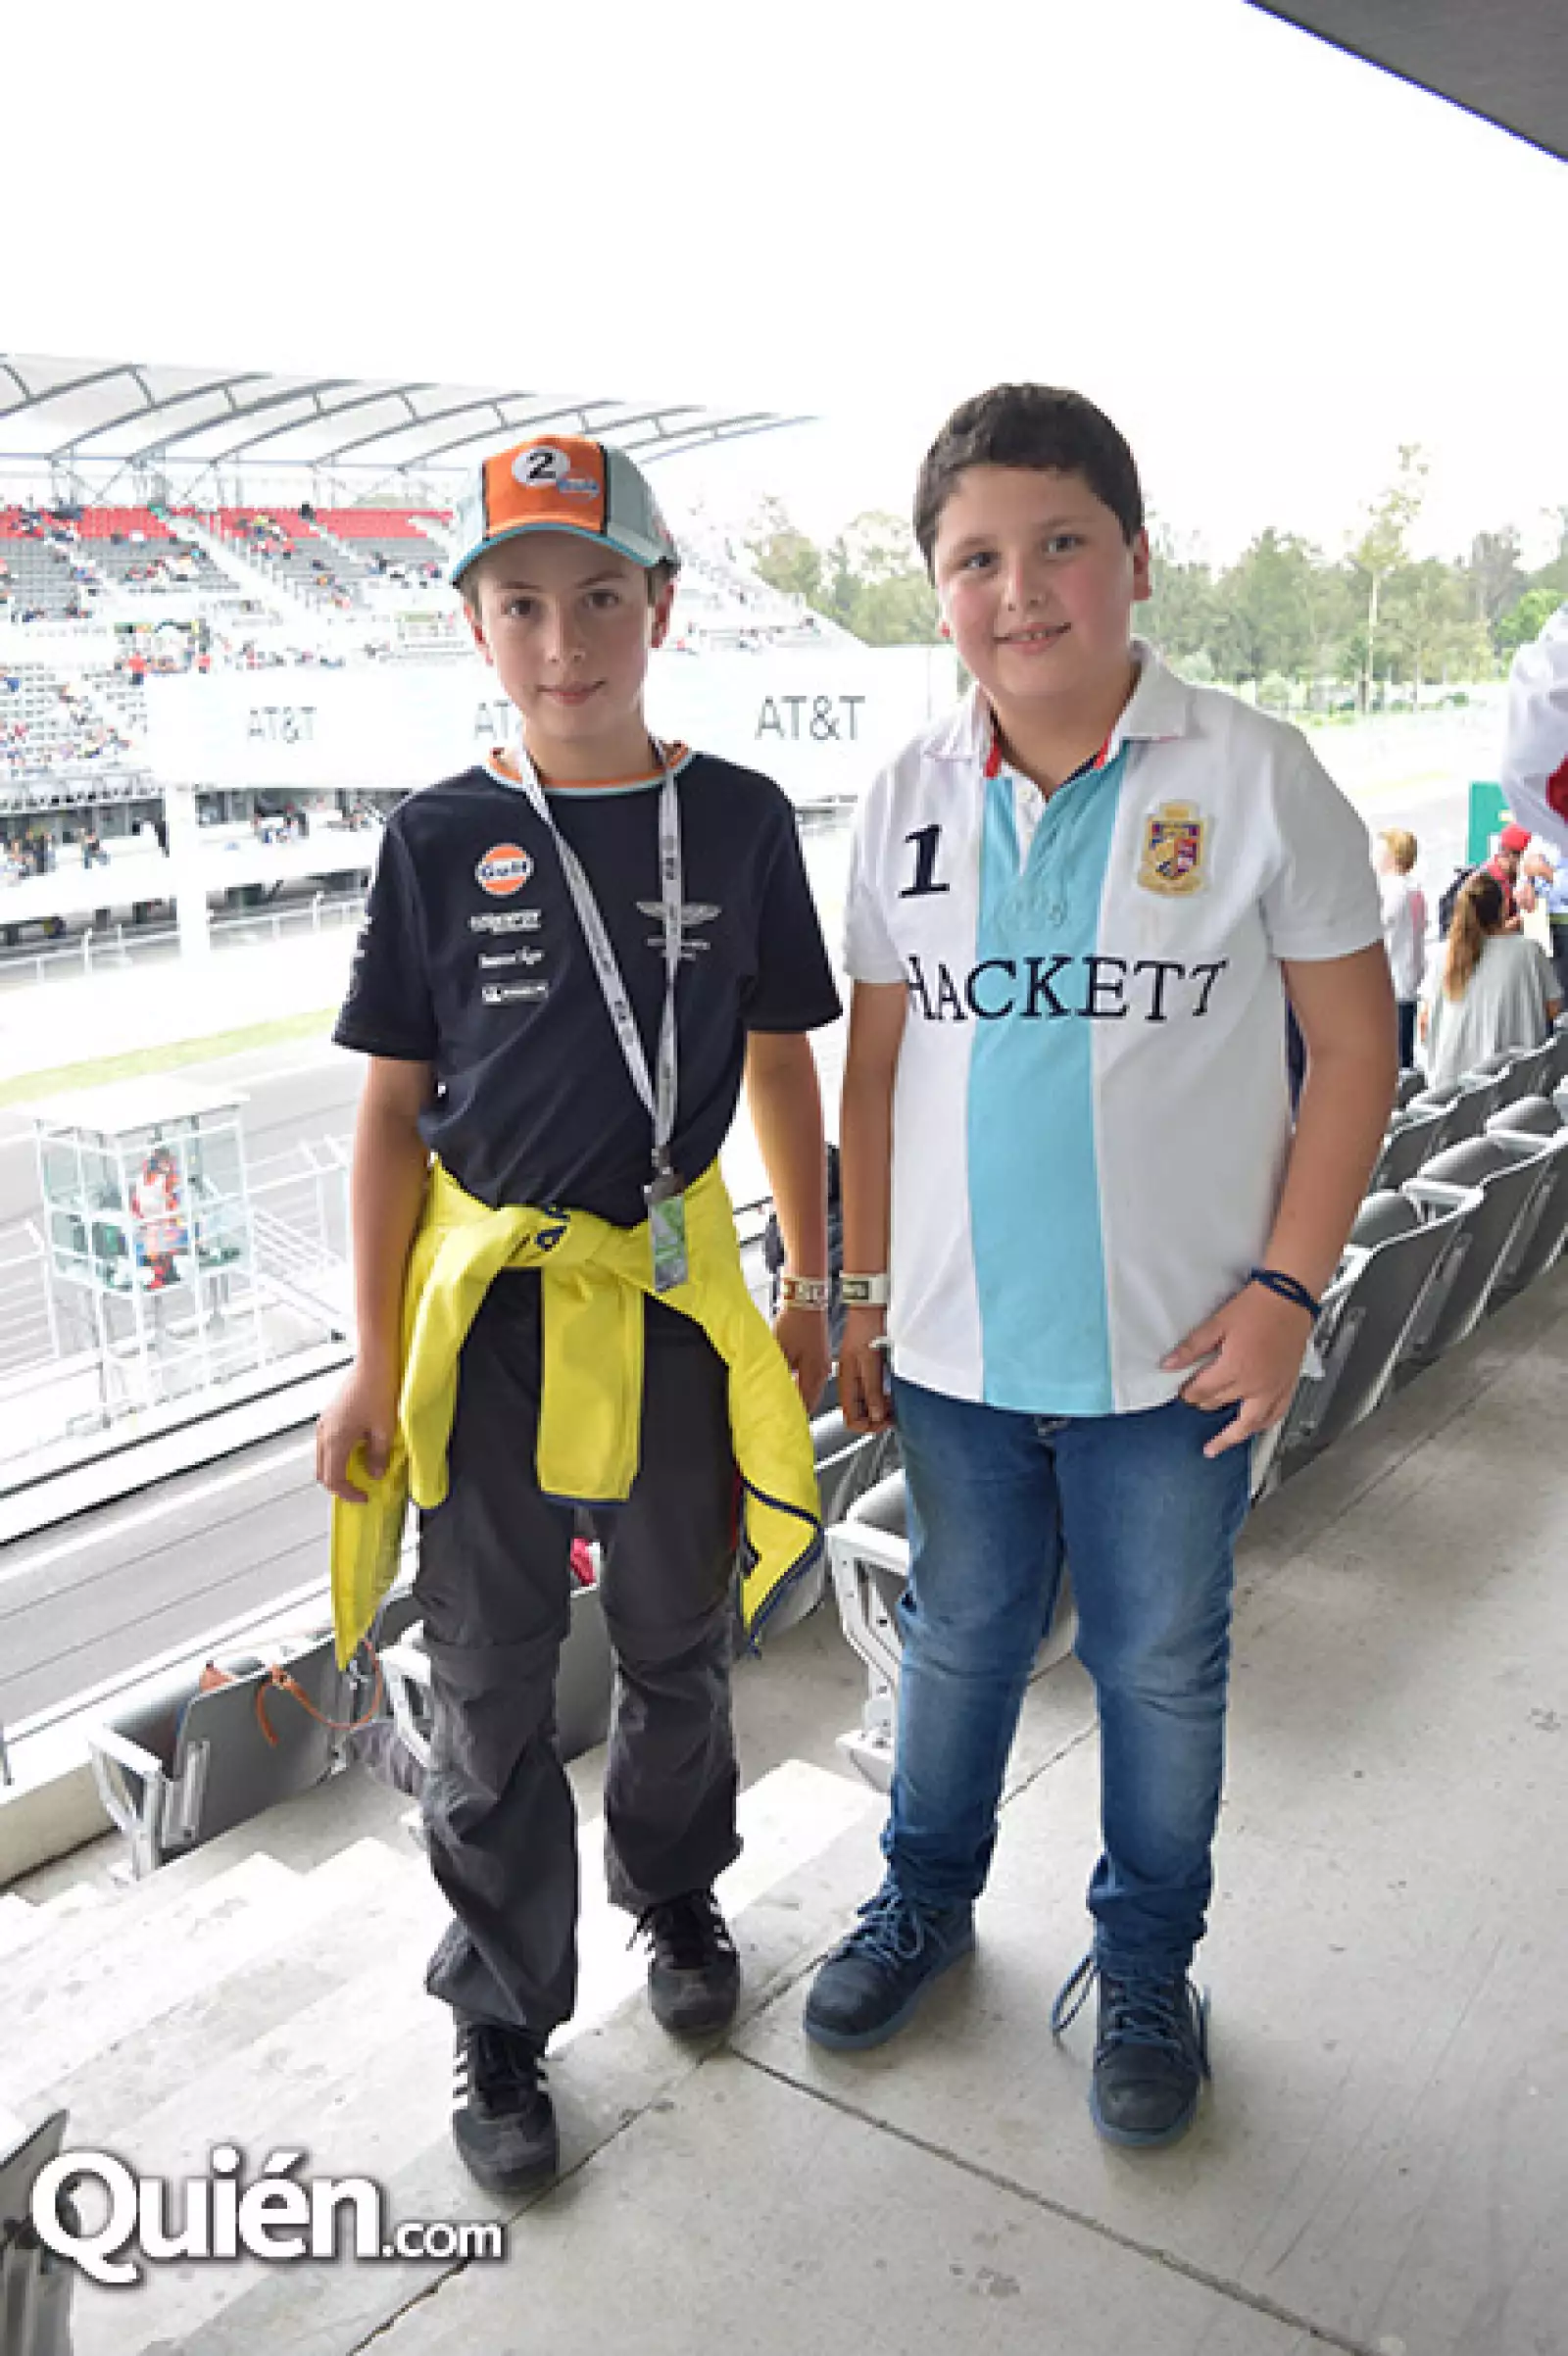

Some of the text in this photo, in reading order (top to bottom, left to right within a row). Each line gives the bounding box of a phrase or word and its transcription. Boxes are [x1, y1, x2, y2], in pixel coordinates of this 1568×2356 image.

[526, 451, 557, 479] 2
[247, 706, 317, 744] AT&T
[754, 695, 866, 741] AT&T
[899, 823, 951, 898] 1
[907, 953, 1230, 1021] HACKETT
